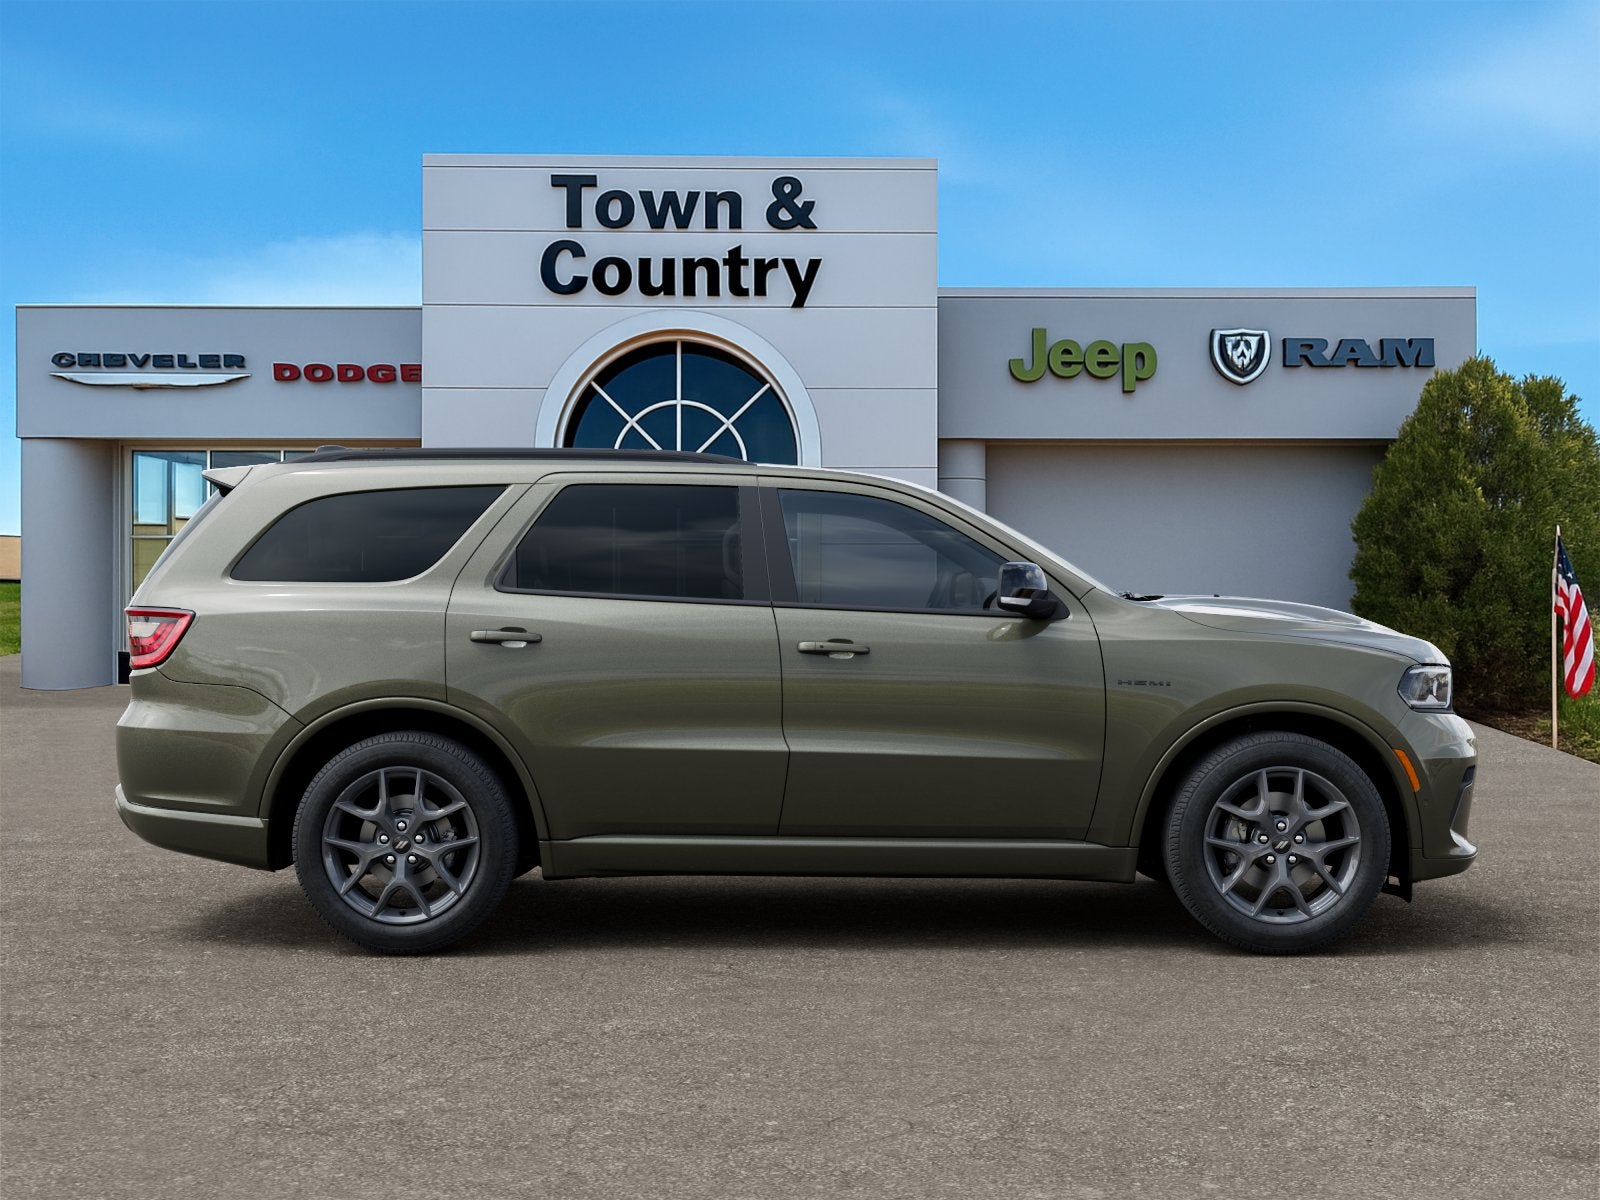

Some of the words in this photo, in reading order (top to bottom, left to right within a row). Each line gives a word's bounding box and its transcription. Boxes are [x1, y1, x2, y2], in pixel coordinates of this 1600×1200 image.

[551, 174, 742, 229] Town
[765, 176, 818, 230] &
[540, 239, 822, 308] Country
[273, 363, 422, 383] DODGE
[1009, 328, 1158, 392] Jeep
[1282, 338, 1435, 368] RAM
